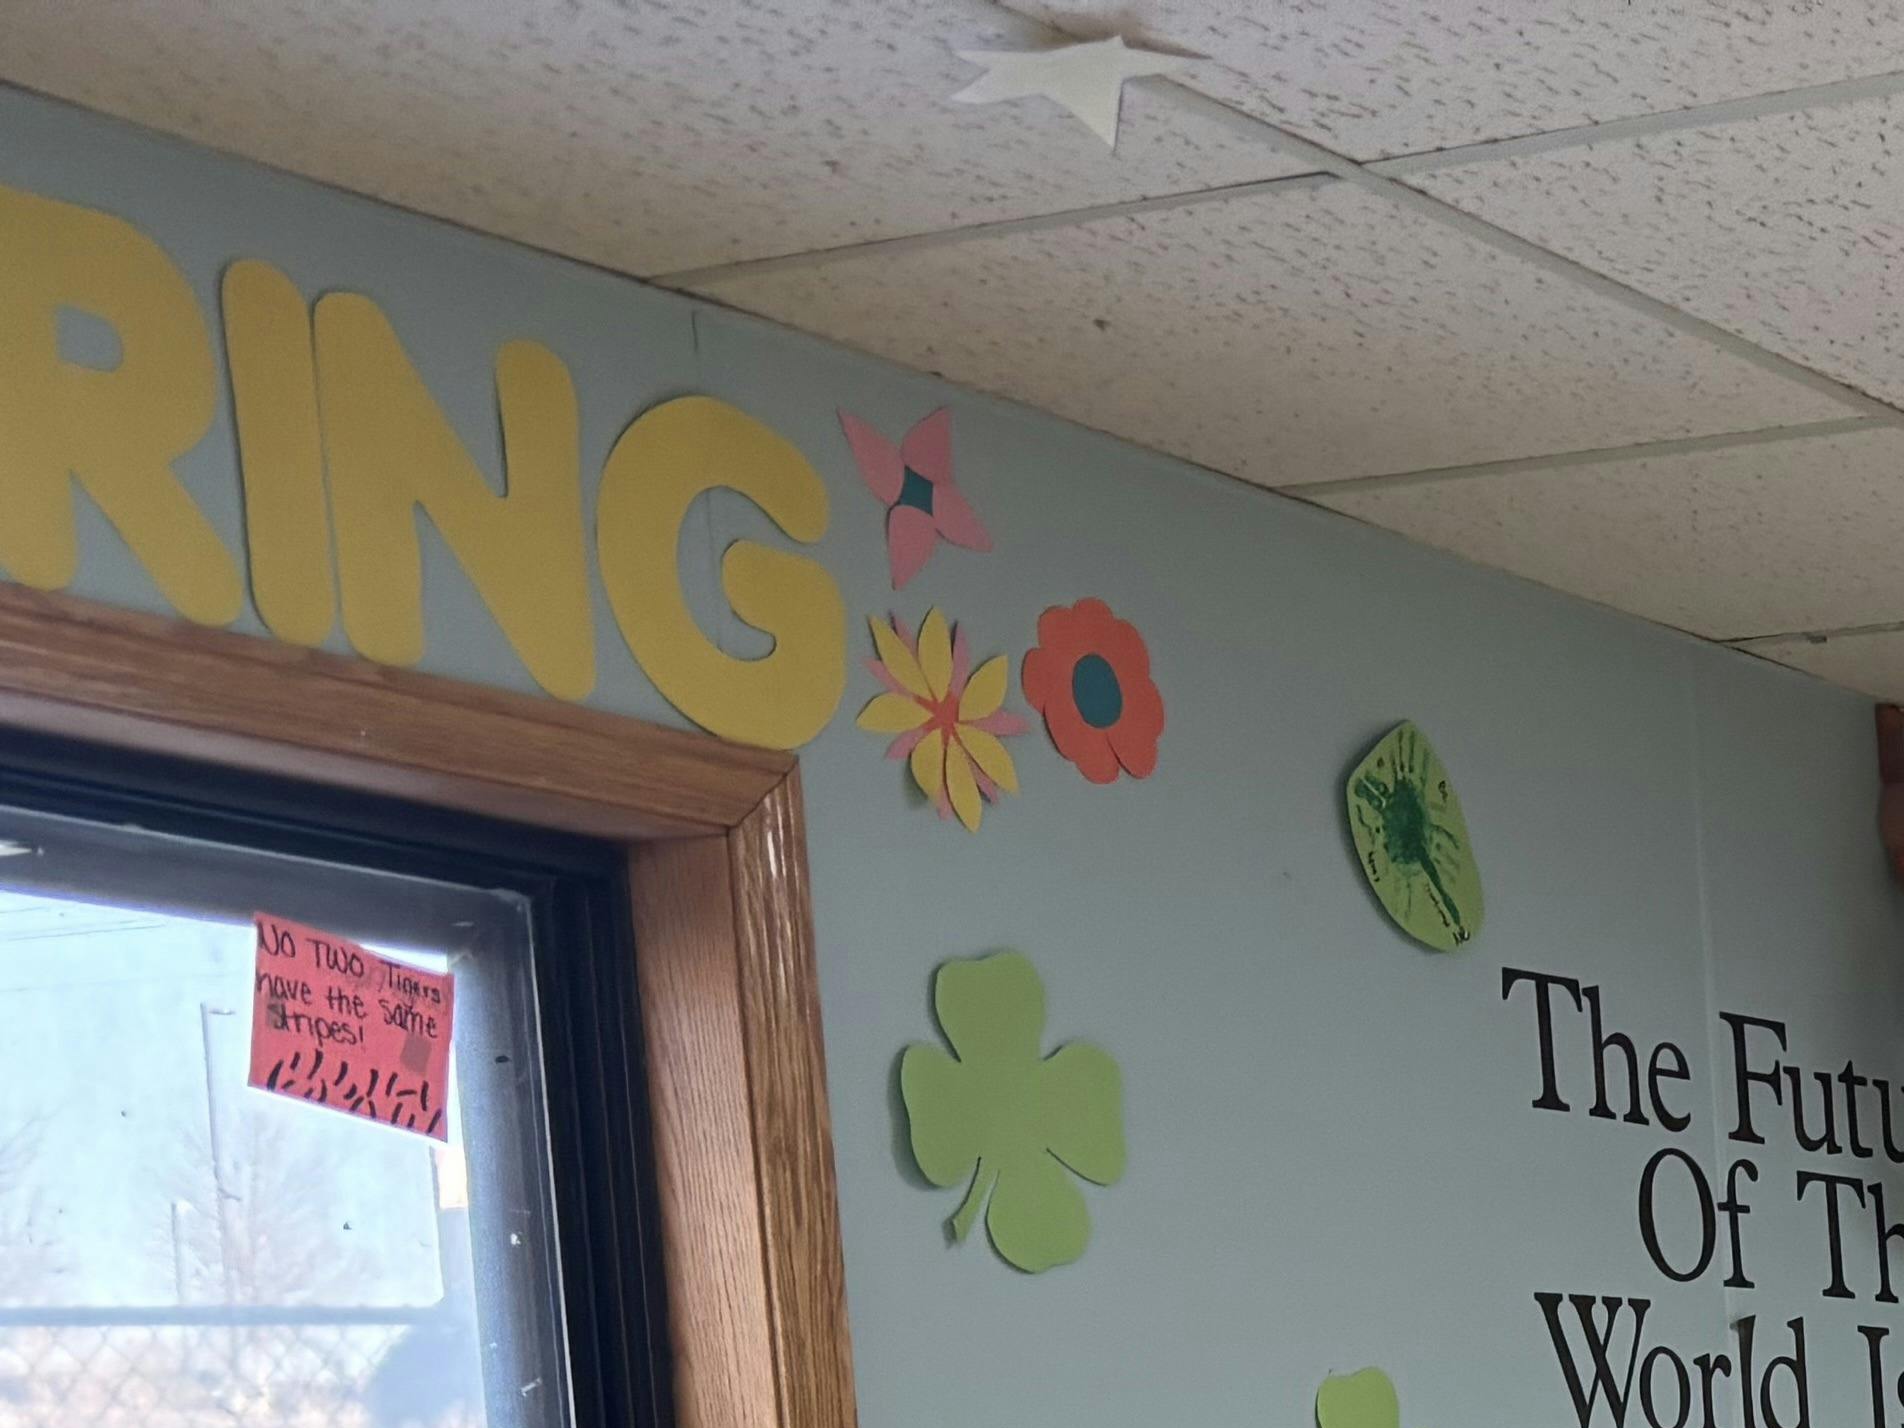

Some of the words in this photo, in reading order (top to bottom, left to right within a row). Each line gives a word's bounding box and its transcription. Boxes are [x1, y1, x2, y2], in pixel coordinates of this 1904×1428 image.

[326, 985, 368, 1021] the
[378, 998, 439, 1040] same
[1501, 966, 1692, 1134] The
[1638, 1147, 1758, 1290] Of
